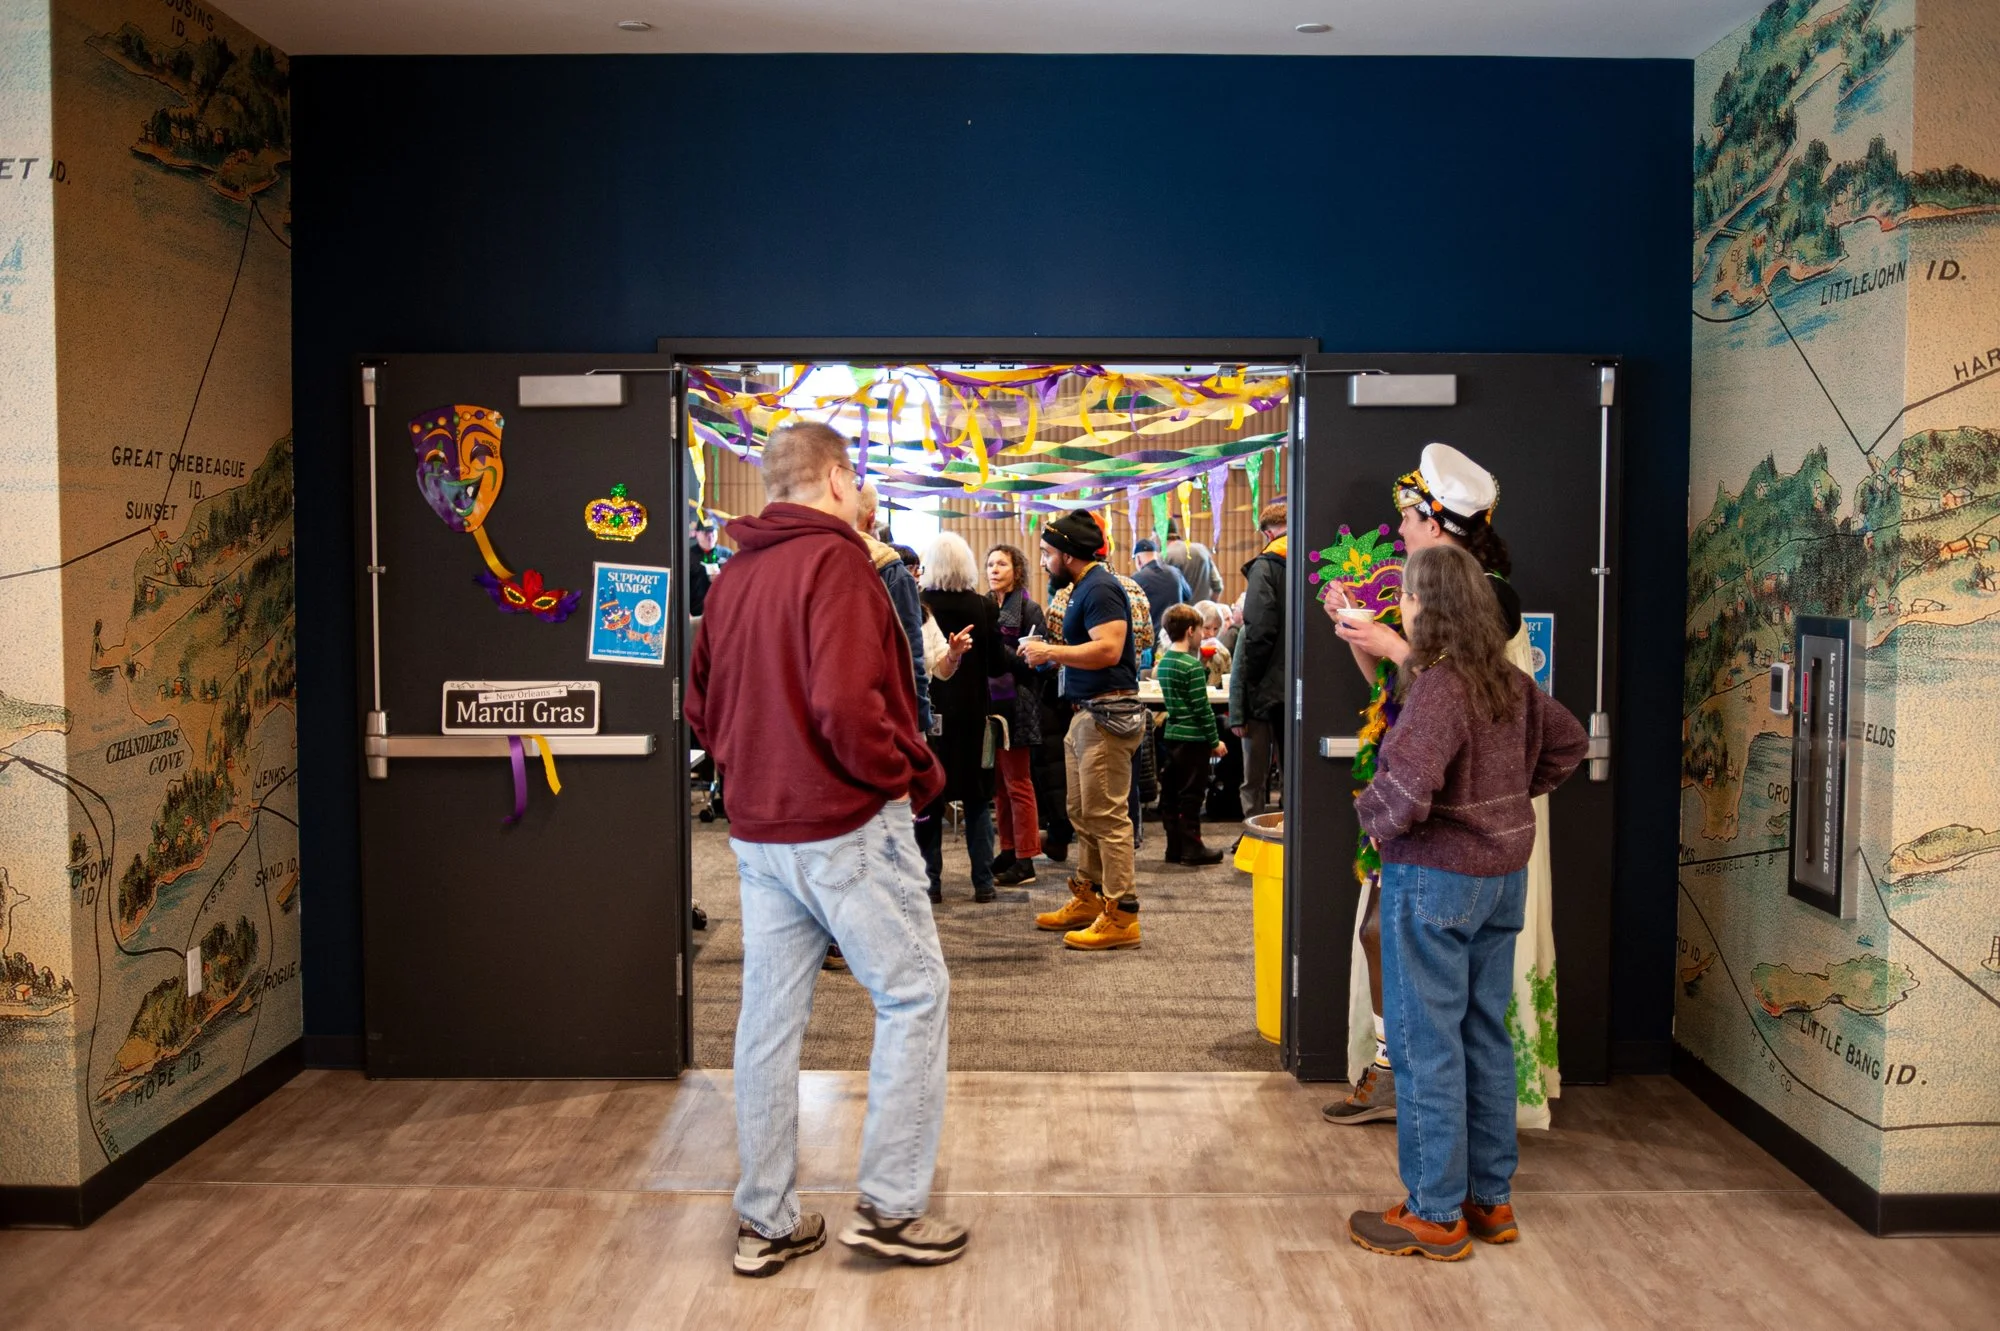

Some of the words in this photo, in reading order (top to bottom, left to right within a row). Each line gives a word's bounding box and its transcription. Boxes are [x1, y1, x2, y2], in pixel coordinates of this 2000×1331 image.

[1820, 259, 1907, 306] LITTLEJOHN
[1926, 260, 1966, 281] ID.
[112, 446, 163, 469] GREAT
[169, 453, 246, 478] CHEBEAGUE
[188, 480, 205, 499] ID.
[125, 501, 178, 520] SUNSET
[607, 571, 660, 585] SUPPORT
[615, 582, 652, 595] WMPG
[1828, 652, 1836, 706] FIRE
[496, 692, 516, 701] New
[517, 689, 551, 699] Orleans
[456, 700, 525, 723] Mardi
[532, 700, 585, 723] Gras
[106, 728, 180, 764] CHANDLERS
[1863, 721, 1896, 748] ELDS
[149, 750, 184, 776] COVE
[255, 765, 286, 789] JENKS
[1823, 713, 1835, 875] EXTINGUISHER
[254, 862, 284, 888] SAND
[264, 961, 296, 993] ROGUE
[1800, 1013, 1843, 1056] LITTLE
[1846, 1043, 1880, 1080] BANG
[1884, 1064, 1928, 1086] ID.
[134, 1065, 176, 1108] HOPE
[95, 1116, 124, 1157] HARP
